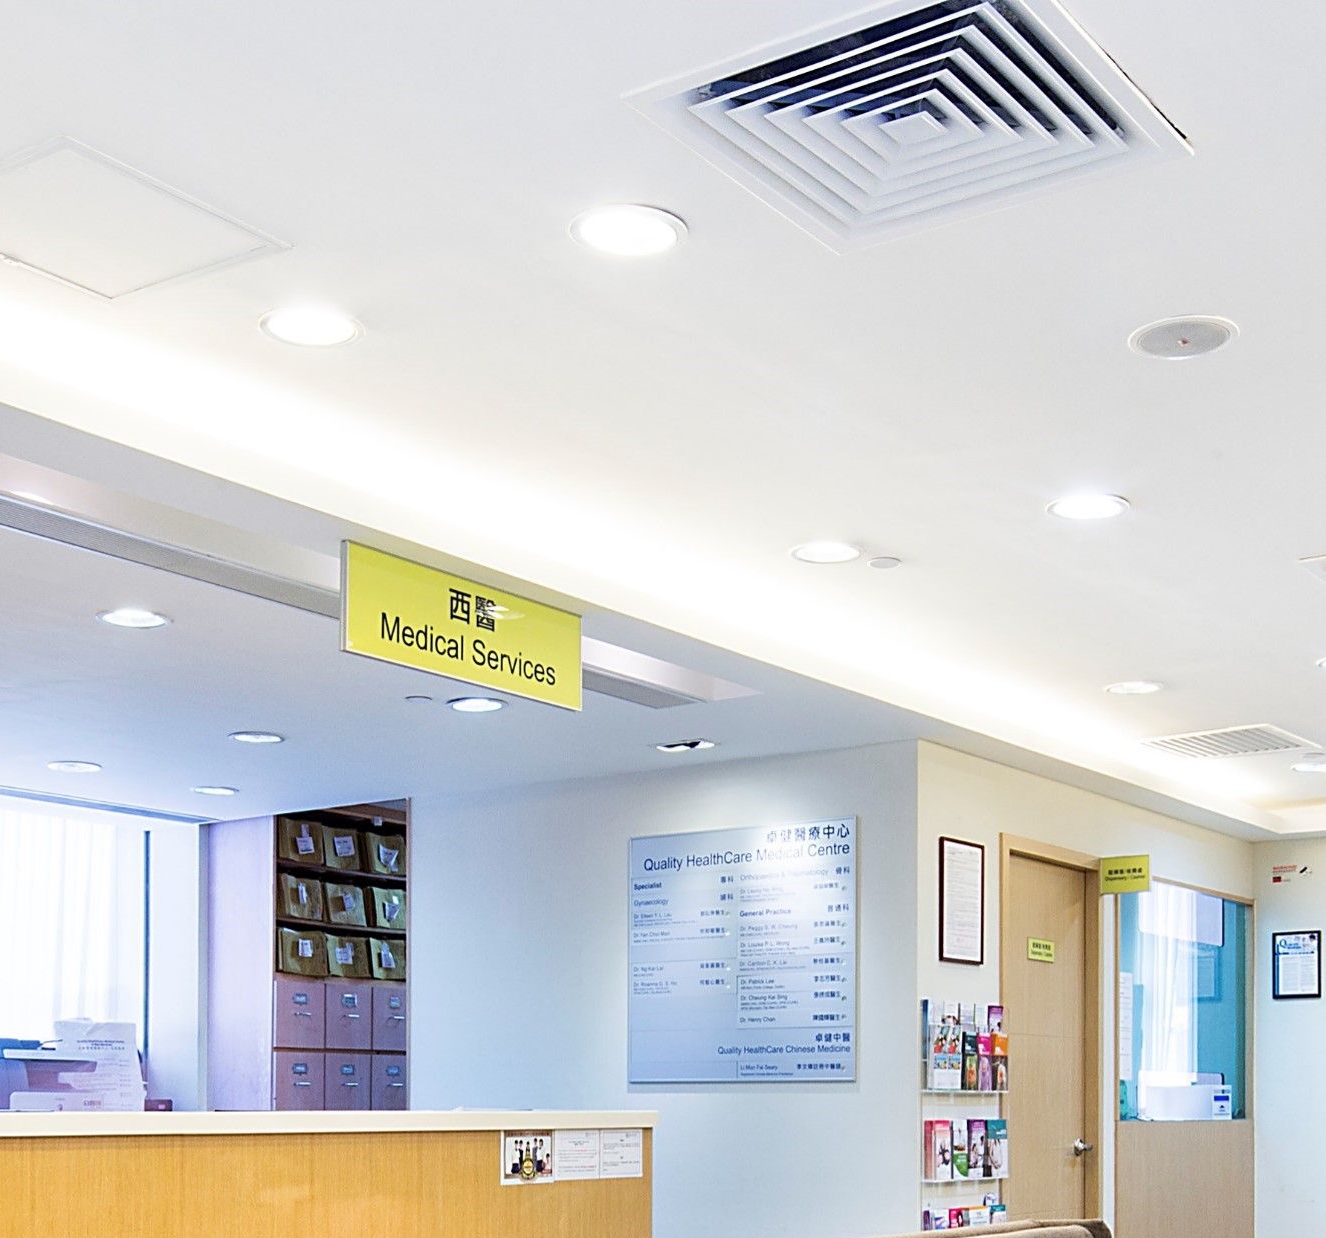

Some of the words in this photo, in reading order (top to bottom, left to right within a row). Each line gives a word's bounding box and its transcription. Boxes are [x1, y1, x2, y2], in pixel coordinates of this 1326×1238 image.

[448, 587, 497, 632] 西醫
[380, 612, 464, 661] Medical
[471, 639, 557, 686] Services
[644, 856, 683, 872] Quality
[686, 850, 753, 867] HealthCare
[756, 845, 803, 861] Medical
[808, 843, 850, 857] Centre
[634, 882, 662, 891] Specialist
[634, 898, 669, 908] Gynaecology
[739, 910, 764, 918] General
[766, 908, 791, 916] Practice
[815, 1032, 850, 1043] 卓健中醫
[718, 1046, 742, 1056] Quality
[743, 1045, 784, 1055] HealthCare
[785, 1044, 815, 1053] Chinese
[817, 1044, 851, 1053] Medicine
